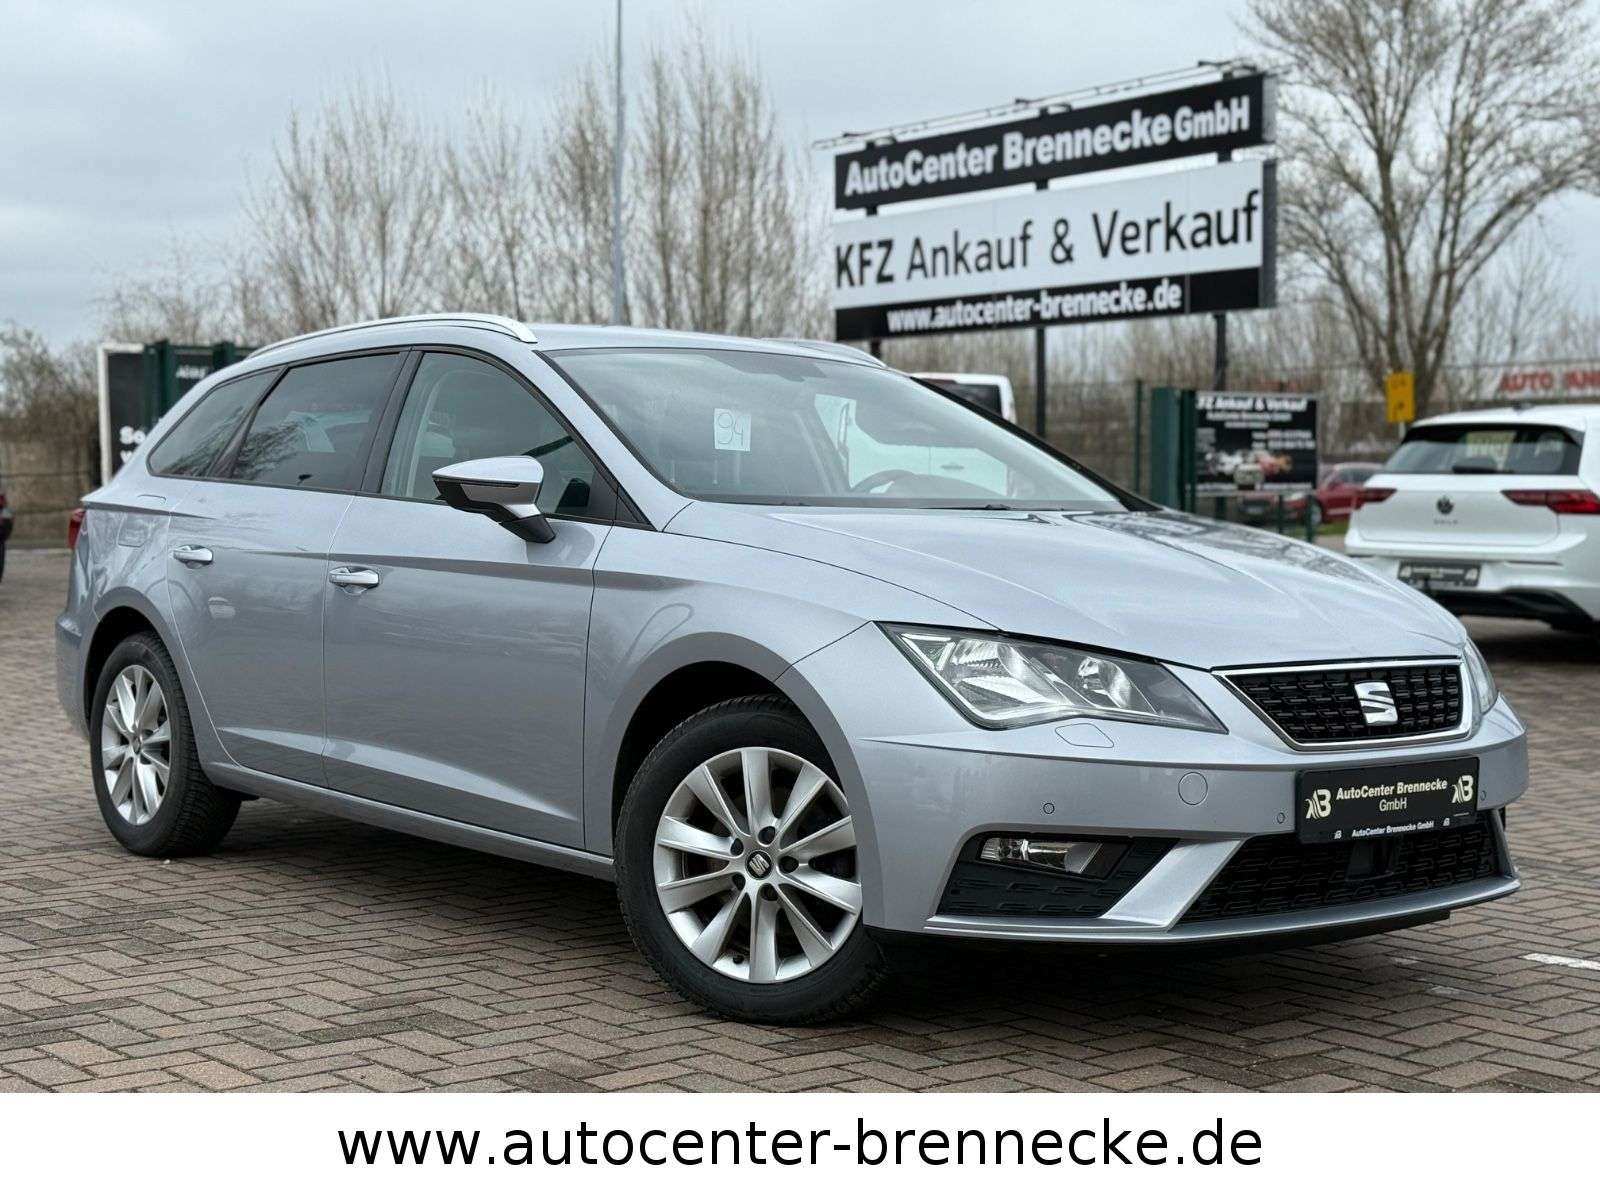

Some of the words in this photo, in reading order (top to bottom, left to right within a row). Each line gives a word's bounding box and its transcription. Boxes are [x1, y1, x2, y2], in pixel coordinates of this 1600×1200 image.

[844, 142, 999, 196] AutoCenter
[1003, 109, 1173, 170] Brennecke
[1174, 95, 1250, 142] GmbH
[836, 240, 895, 288] KFZ
[907, 219, 1034, 280] Ankauf
[1050, 218, 1074, 265] &
[1093, 189, 1258, 259] Verkauf
[887, 279, 1181, 333] www.autocenter-brennecke.de
[1336, 784, 1395, 801] AutoCenter
[1396, 777, 1448, 794] Brennecke
[1379, 797, 1408, 812] GmbH
[1351, 827, 1386, 838] AutoCenter
[1386, 823, 1416, 834] Brennecke
[1417, 820, 1434, 831] GmbH
